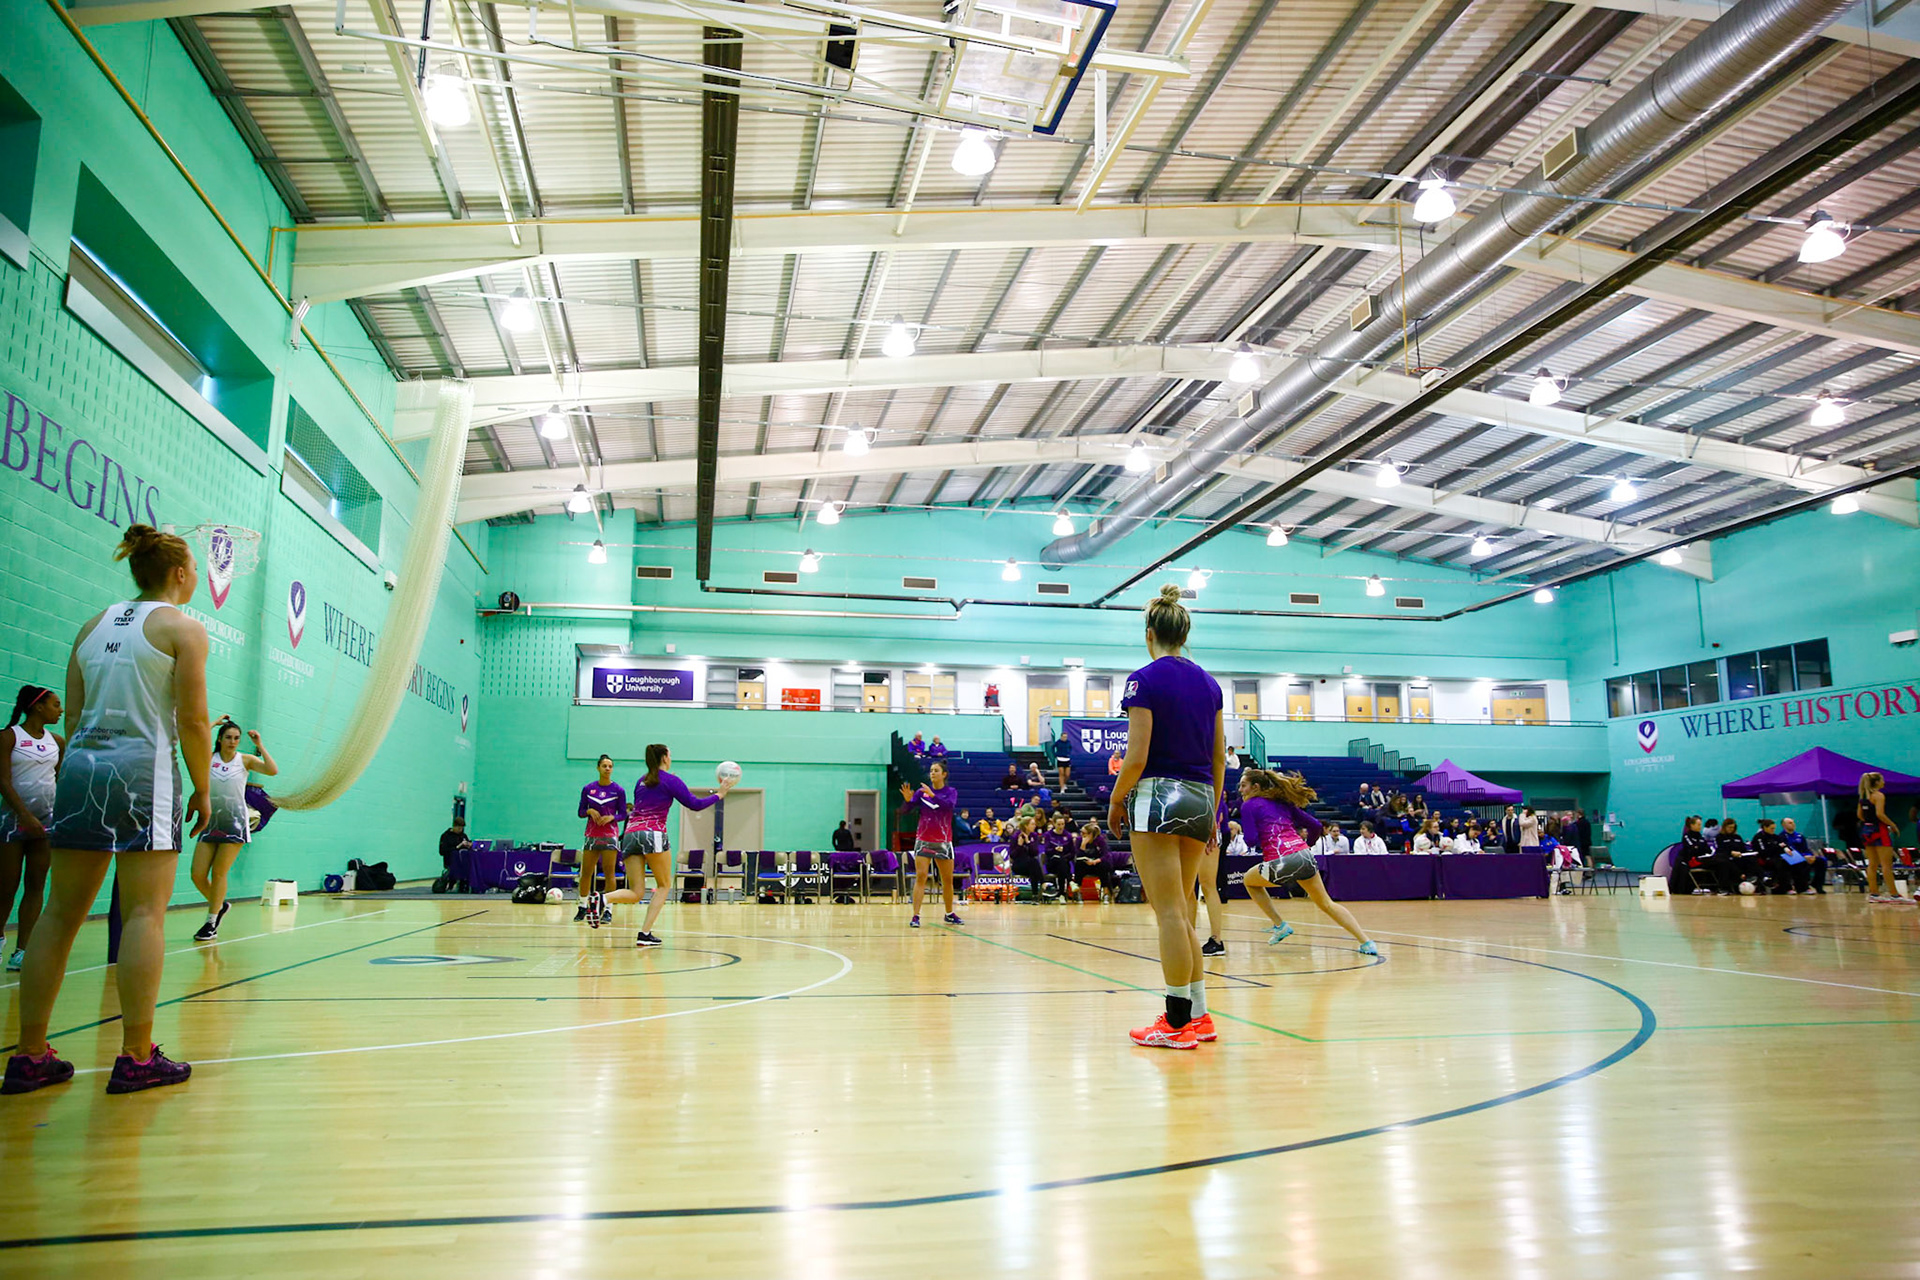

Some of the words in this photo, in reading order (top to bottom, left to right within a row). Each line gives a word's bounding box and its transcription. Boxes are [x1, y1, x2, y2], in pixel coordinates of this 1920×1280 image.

[0, 390, 160, 530] BEGINS
[323, 601, 375, 668] WHERE
[425, 670, 456, 714] BEGINS
[625, 675, 680, 686] Loughborough
[625, 684, 663, 694] University
[1680, 705, 1774, 738] WHERE
[1782, 686, 1920, 727] HISTORY
